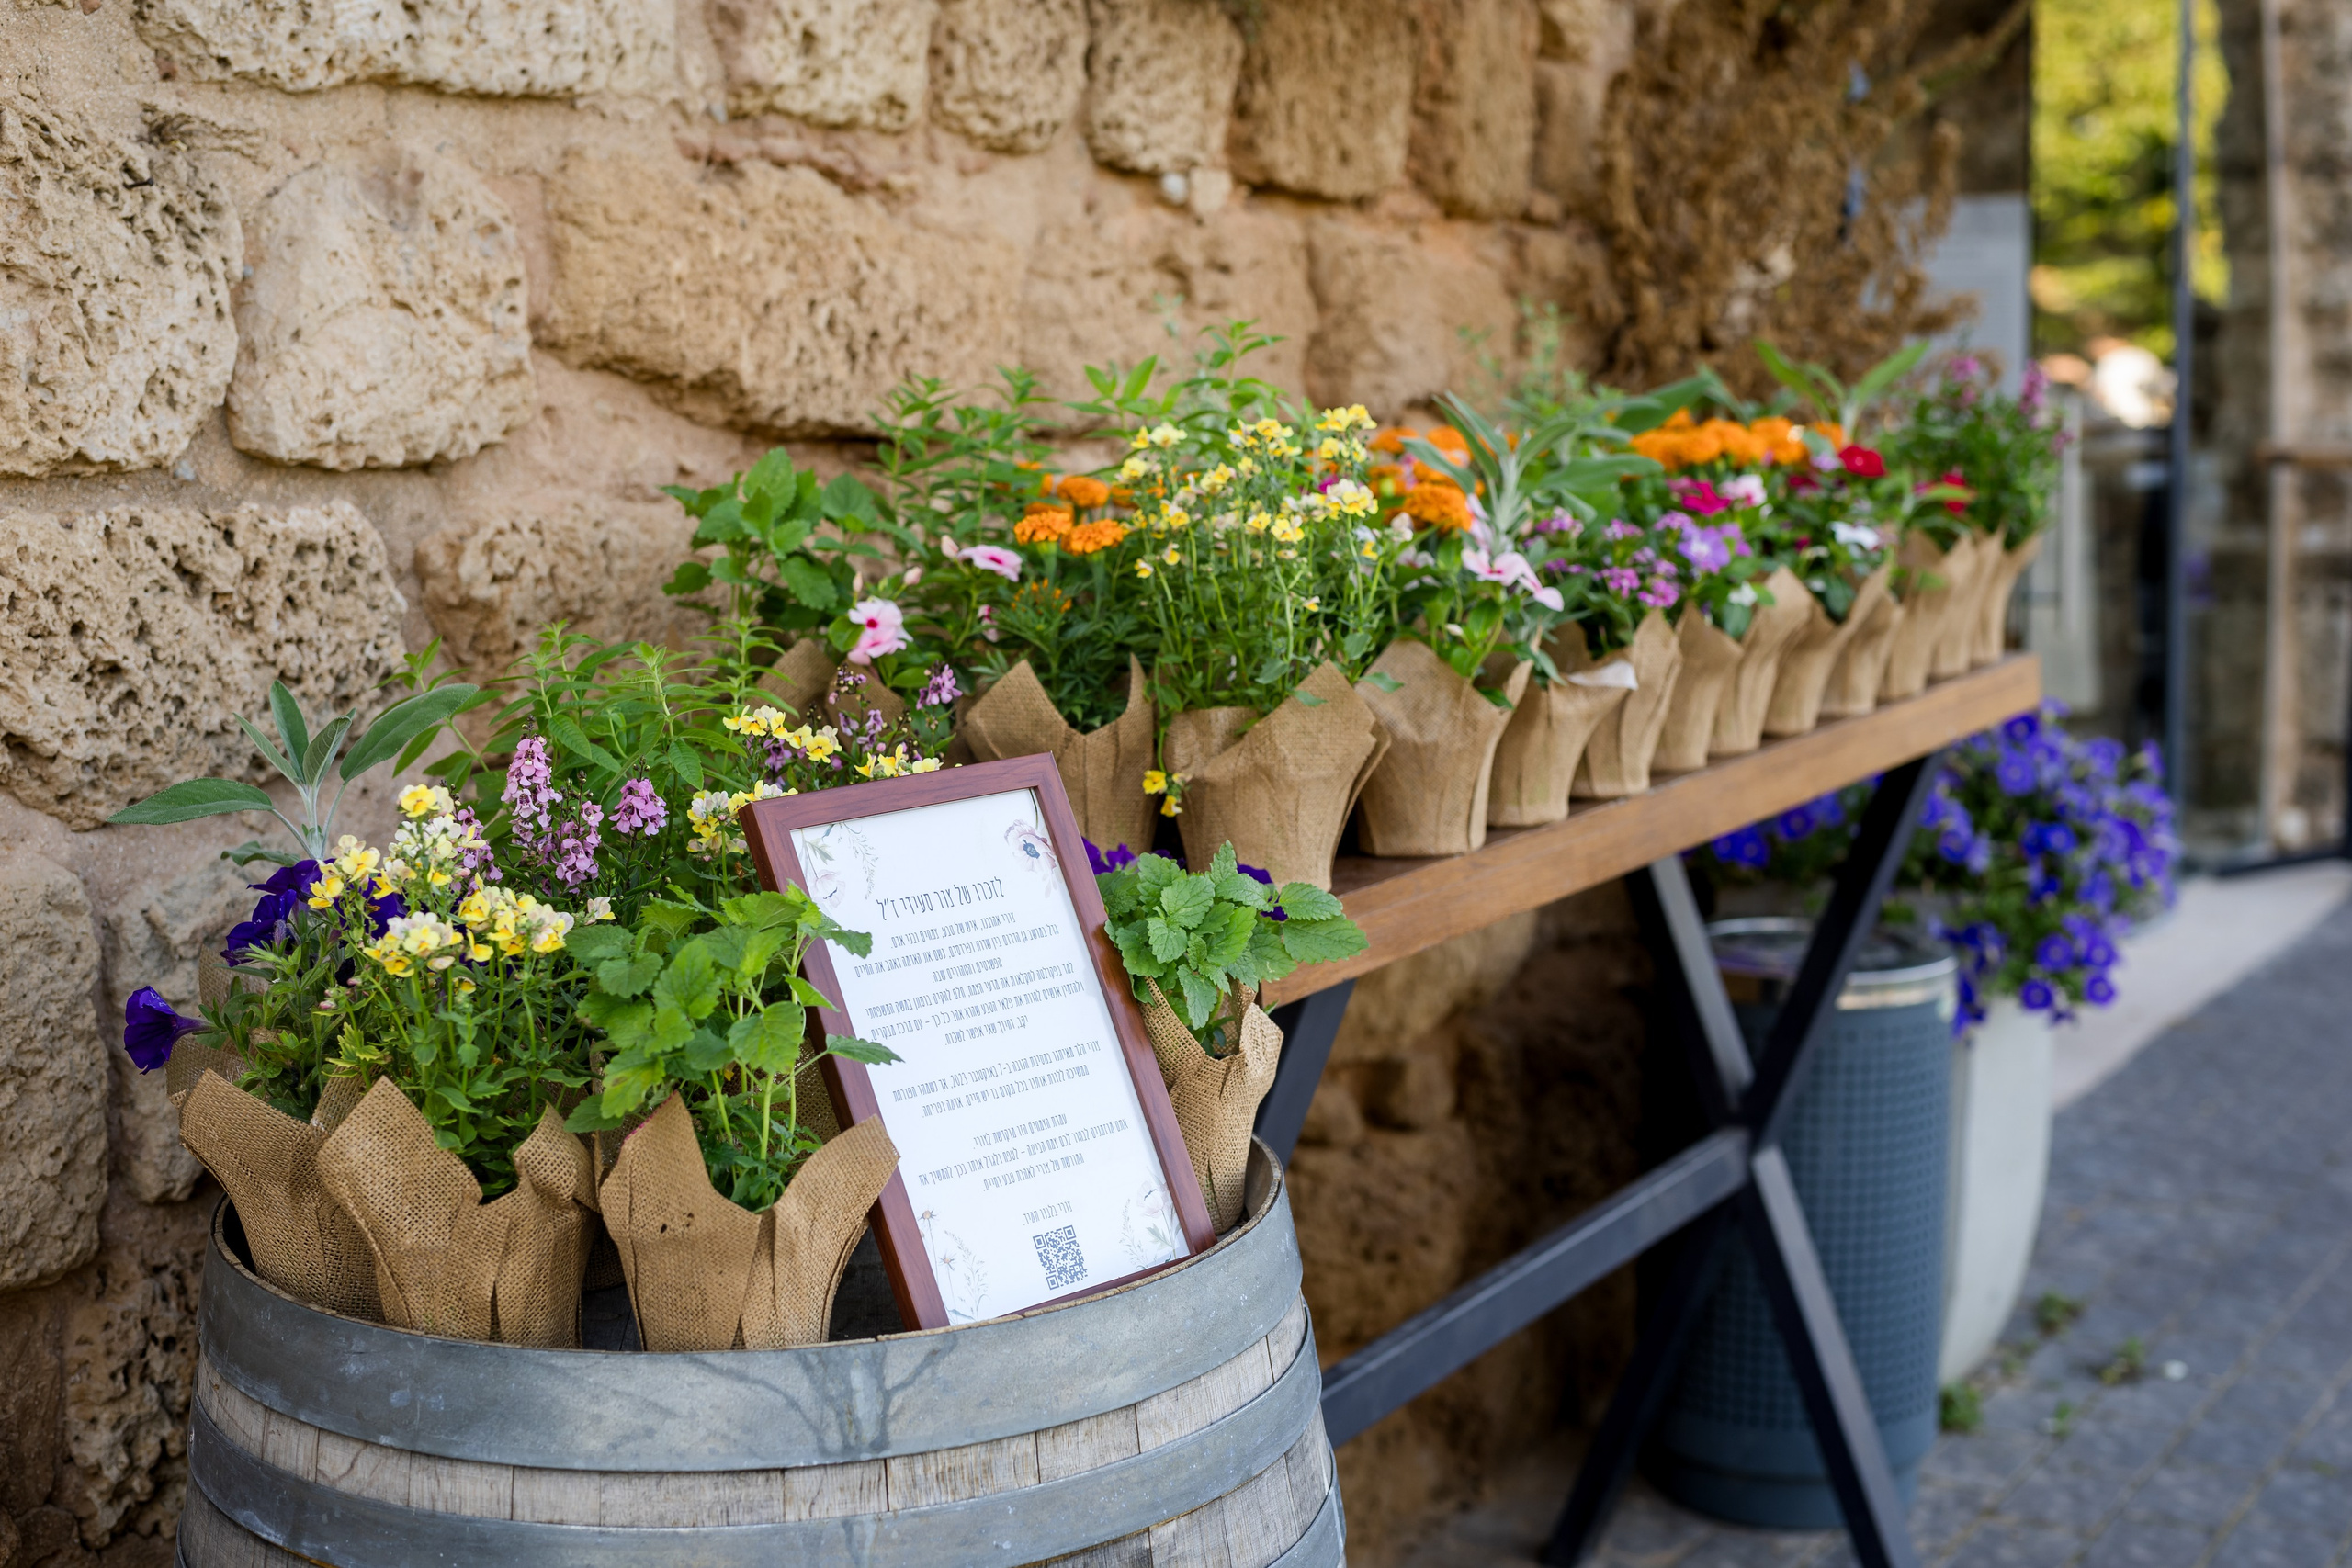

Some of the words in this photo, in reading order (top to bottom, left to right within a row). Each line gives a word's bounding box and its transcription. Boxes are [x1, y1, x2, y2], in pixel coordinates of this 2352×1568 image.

[953, 884, 972, 906] של
[971, 875, 1005, 902] לזכרו
[899, 892, 934, 915] סעידי
[933, 887, 956, 909] צור
[1001, 911, 1016, 924] צורי
[953, 921, 966, 935] של
[964, 919, 979, 933] איש
[1026, 926, 1048, 941] במושב
[1046, 923, 1060, 937] גדל
[904, 931, 921, 945] ובני
[919, 927, 940, 942] צמחים
[1001, 931, 1022, 947] הדרום
[1020, 930, 1029, 944] גן
[974, 938, 992, 953] שדות
[990, 935, 1003, 951] בין
[900, 953, 923, 968] האדמה
[922, 951, 934, 964] את
[932, 947, 947, 962] נשם
[854, 963, 876, 978] החיים
[874, 961, 887, 975] את
[884, 957, 902, 972] ואהב
[945, 963, 977, 980] והטהורים
[975, 956, 1003, 974] הפשוטים
[1061, 960, 1075, 975] למד
[1009, 969, 1036, 987] לחקלאות
[1035, 964, 1063, 981] בפקולטה
[983, 978, 1001, 992] מדעי
[999, 976, 1011, 989] את
[1060, 979, 1085, 998] ולהזמין
[932, 987, 953, 1005] להקים
[951, 986, 967, 1000] חלם
[1023, 988, 1043, 1005] לחוות
[1041, 986, 1063, 1001] אנשים
[894, 998, 914, 1015] במשק
[912, 994, 933, 1011] בוסתן
[979, 1000, 999, 1016] הטבע
[996, 996, 1014, 1010] פלאי
[1012, 994, 1025, 1008] את
[864, 1002, 896, 1020] המשפחתי
[939, 1010, 951, 1025] כל
[950, 1008, 966, 1022] אהב
[963, 1004, 981, 1020] שהוא
[895, 1020, 914, 1035] מרכז
[912, 1018, 924, 1032] עם
[931, 1013, 942, 1029] כך
[983, 1022, 998, 1035] שאי
[996, 1018, 1016, 1034] וחיוך
[965, 1025, 985, 1040] אפשר
[1051, 1046, 1075, 1062] מאיתנו
[1073, 1043, 1088, 1058] הלך
[1085, 1040, 1102, 1053] צורי
[1011, 1057, 1030, 1073] הנובה
[1028, 1052, 1053, 1068] במסיבת
[967, 1066, 1000, 1083] באוקטובר
[1046, 1068, 1066, 1086] ללוות
[1065, 1064, 1090, 1080] ממשיכה
[916, 1080, 939, 1096] נשמתו
[937, 1077, 949, 1093] אך
[1013, 1079, 1030, 1094] בכל
[1027, 1075, 1048, 1089] אותנו
[979, 1089, 990, 1102] יש
[989, 1087, 1000, 1100] בו
[998, 1083, 1016, 1098] מקום
[944, 1096, 965, 1111] אדמה
[1027, 1117, 1052, 1134] הצמחים
[1050, 1113, 1068, 1128] עמדת
[1114, 1118, 1129, 1133] אתם
[991, 1126, 1018, 1145] מוקדשת
[1015, 1123, 1029, 1137] הזו
[1070, 1127, 1091, 1144] לבחור
[1090, 1122, 1115, 1139] מוזמנים
[1046, 1137, 1059, 1151] צמח
[1057, 1132, 1072, 1148] לכם
[1001, 1146, 1020, 1164] לטפח
[1025, 1141, 1047, 1156] הביתה
[967, 1157, 985, 1173] אותו
[982, 1152, 1003, 1168] ולגדל
[1049, 1158, 1061, 1172] של
[1059, 1152, 1085, 1169] המורשת
[928, 1165, 954, 1186] להמשיך
[1014, 1164, 1036, 1182] לאהבת
[1035, 1161, 1052, 1175] צורי
[918, 1173, 930, 1187] את
[1001, 1171, 1016, 1187] טבע
[1038, 1204, 1059, 1220] בלבנו
[1057, 1200, 1073, 1213] צורי
